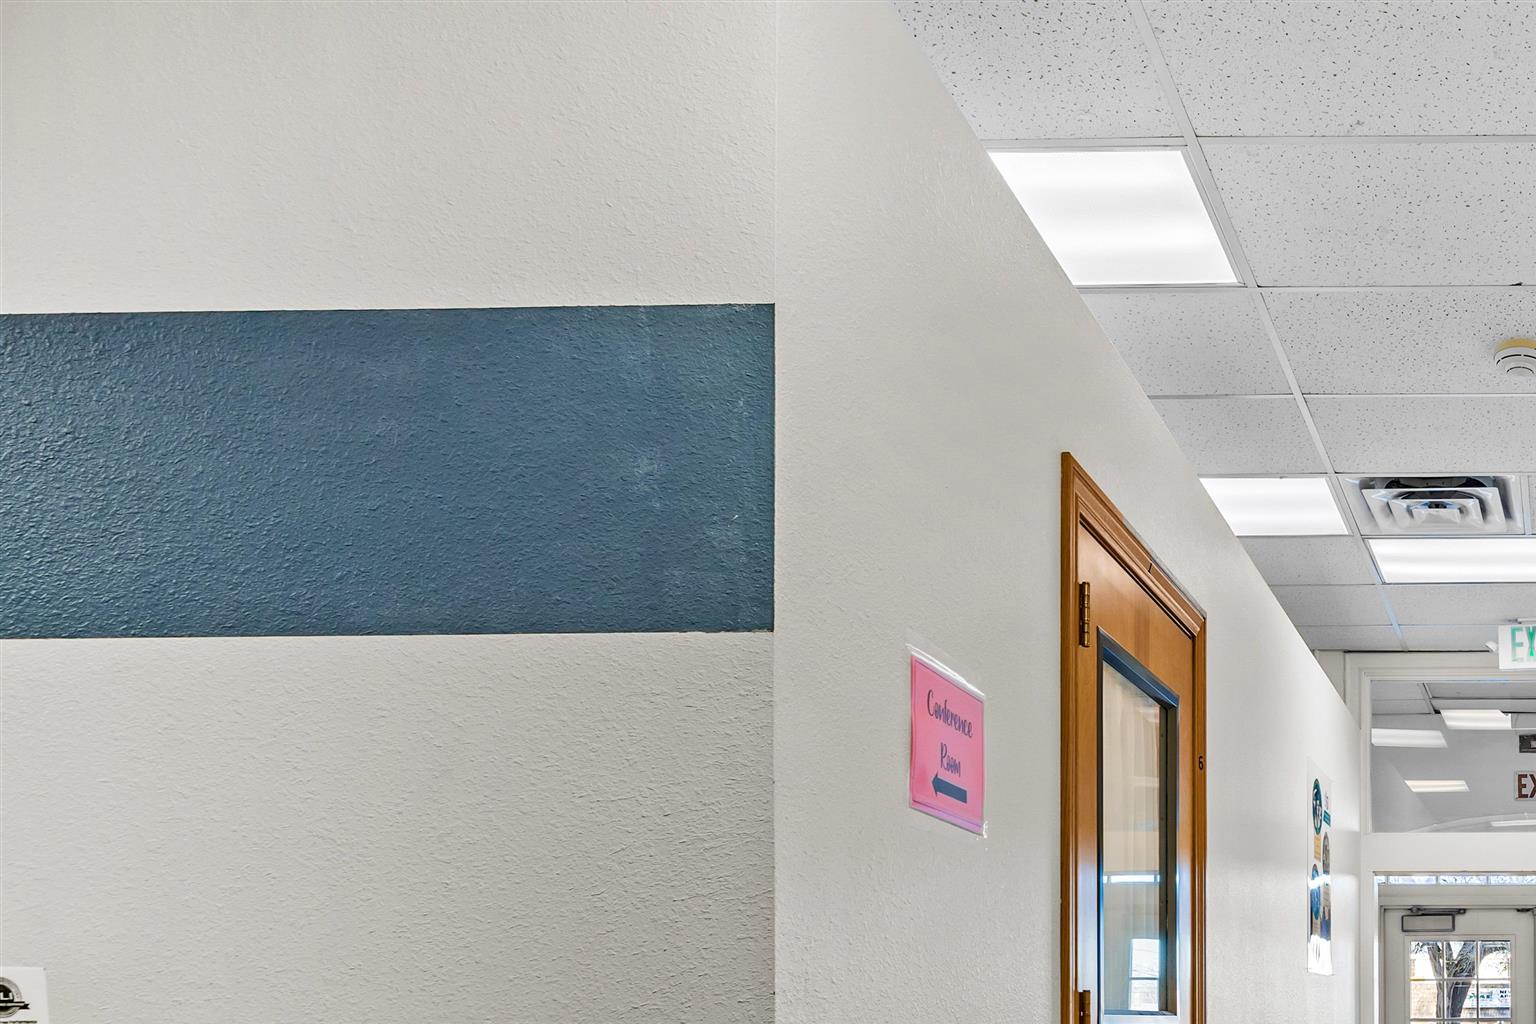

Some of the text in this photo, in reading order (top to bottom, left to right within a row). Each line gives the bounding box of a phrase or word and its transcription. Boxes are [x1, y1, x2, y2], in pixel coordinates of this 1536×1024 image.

[927, 689, 973, 739] Conference
[940, 742, 961, 777] Room
[1198, 755, 1204, 771] 6
